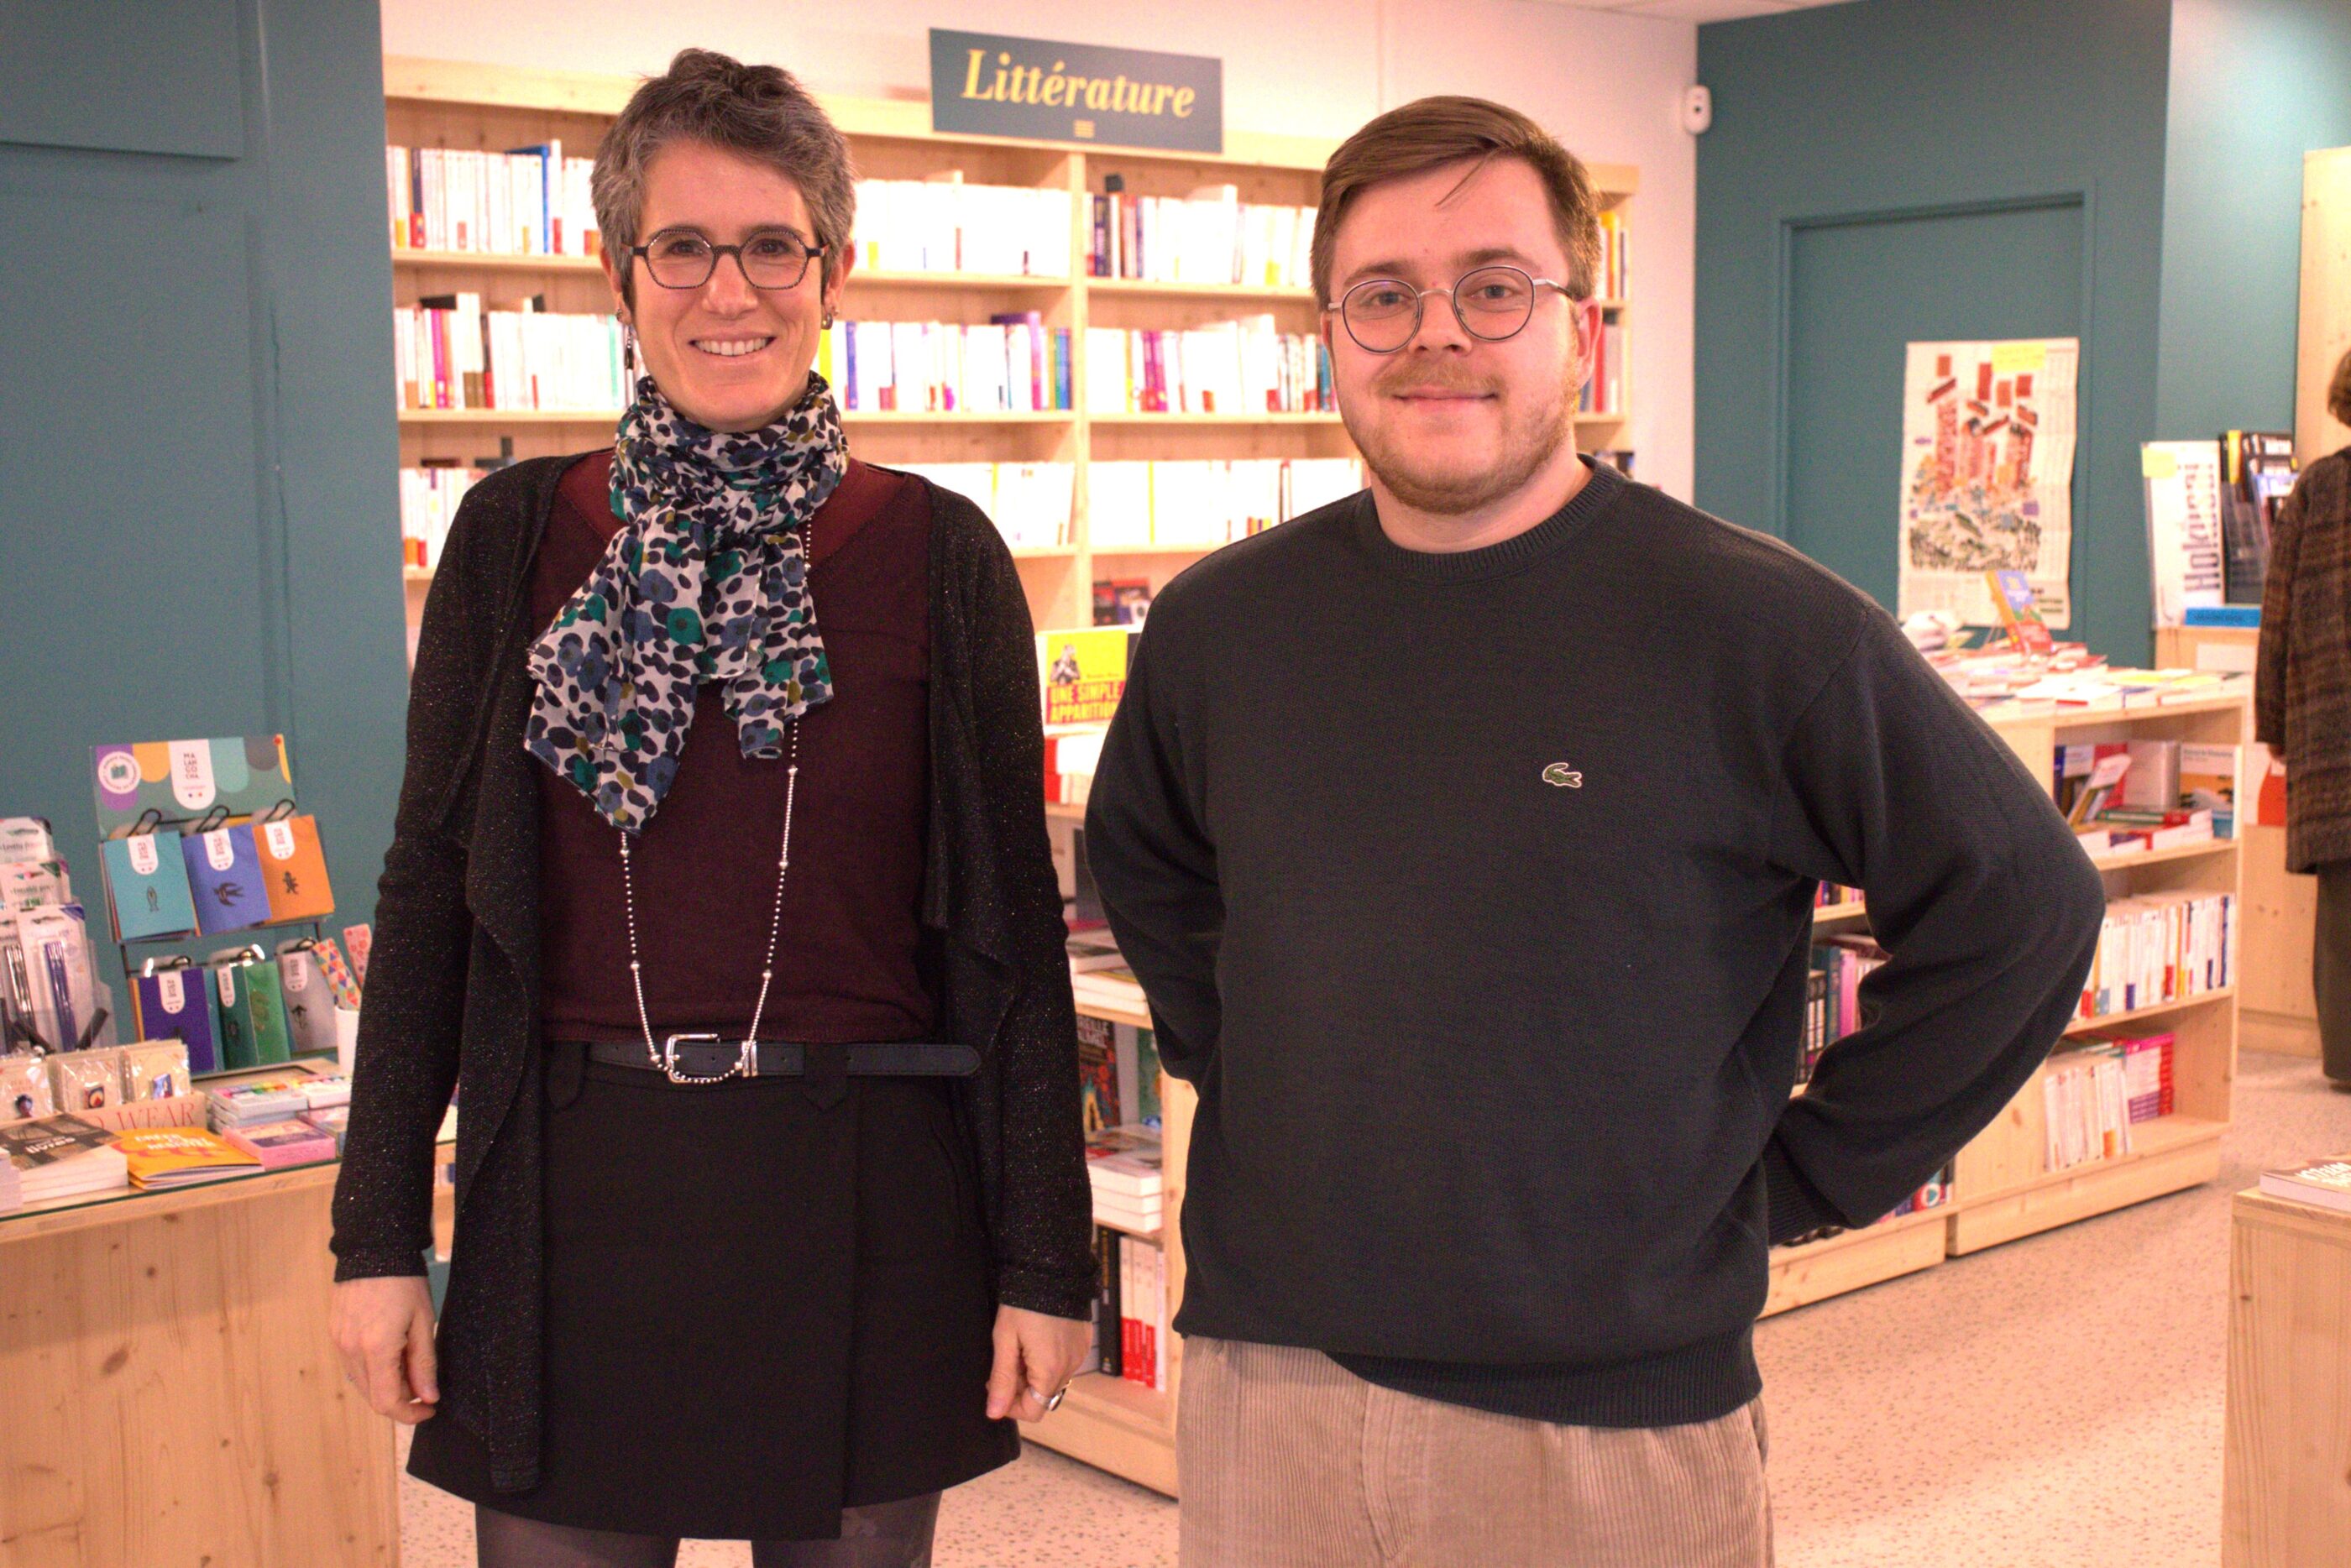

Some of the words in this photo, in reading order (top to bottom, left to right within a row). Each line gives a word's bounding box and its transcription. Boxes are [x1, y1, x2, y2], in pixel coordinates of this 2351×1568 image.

[961, 48, 1196, 118] Littérature
[1050, 686, 1073, 703] UNE
[1078, 682, 1121, 702] SIMPLE
[116, 1102, 195, 1130] WEAR
